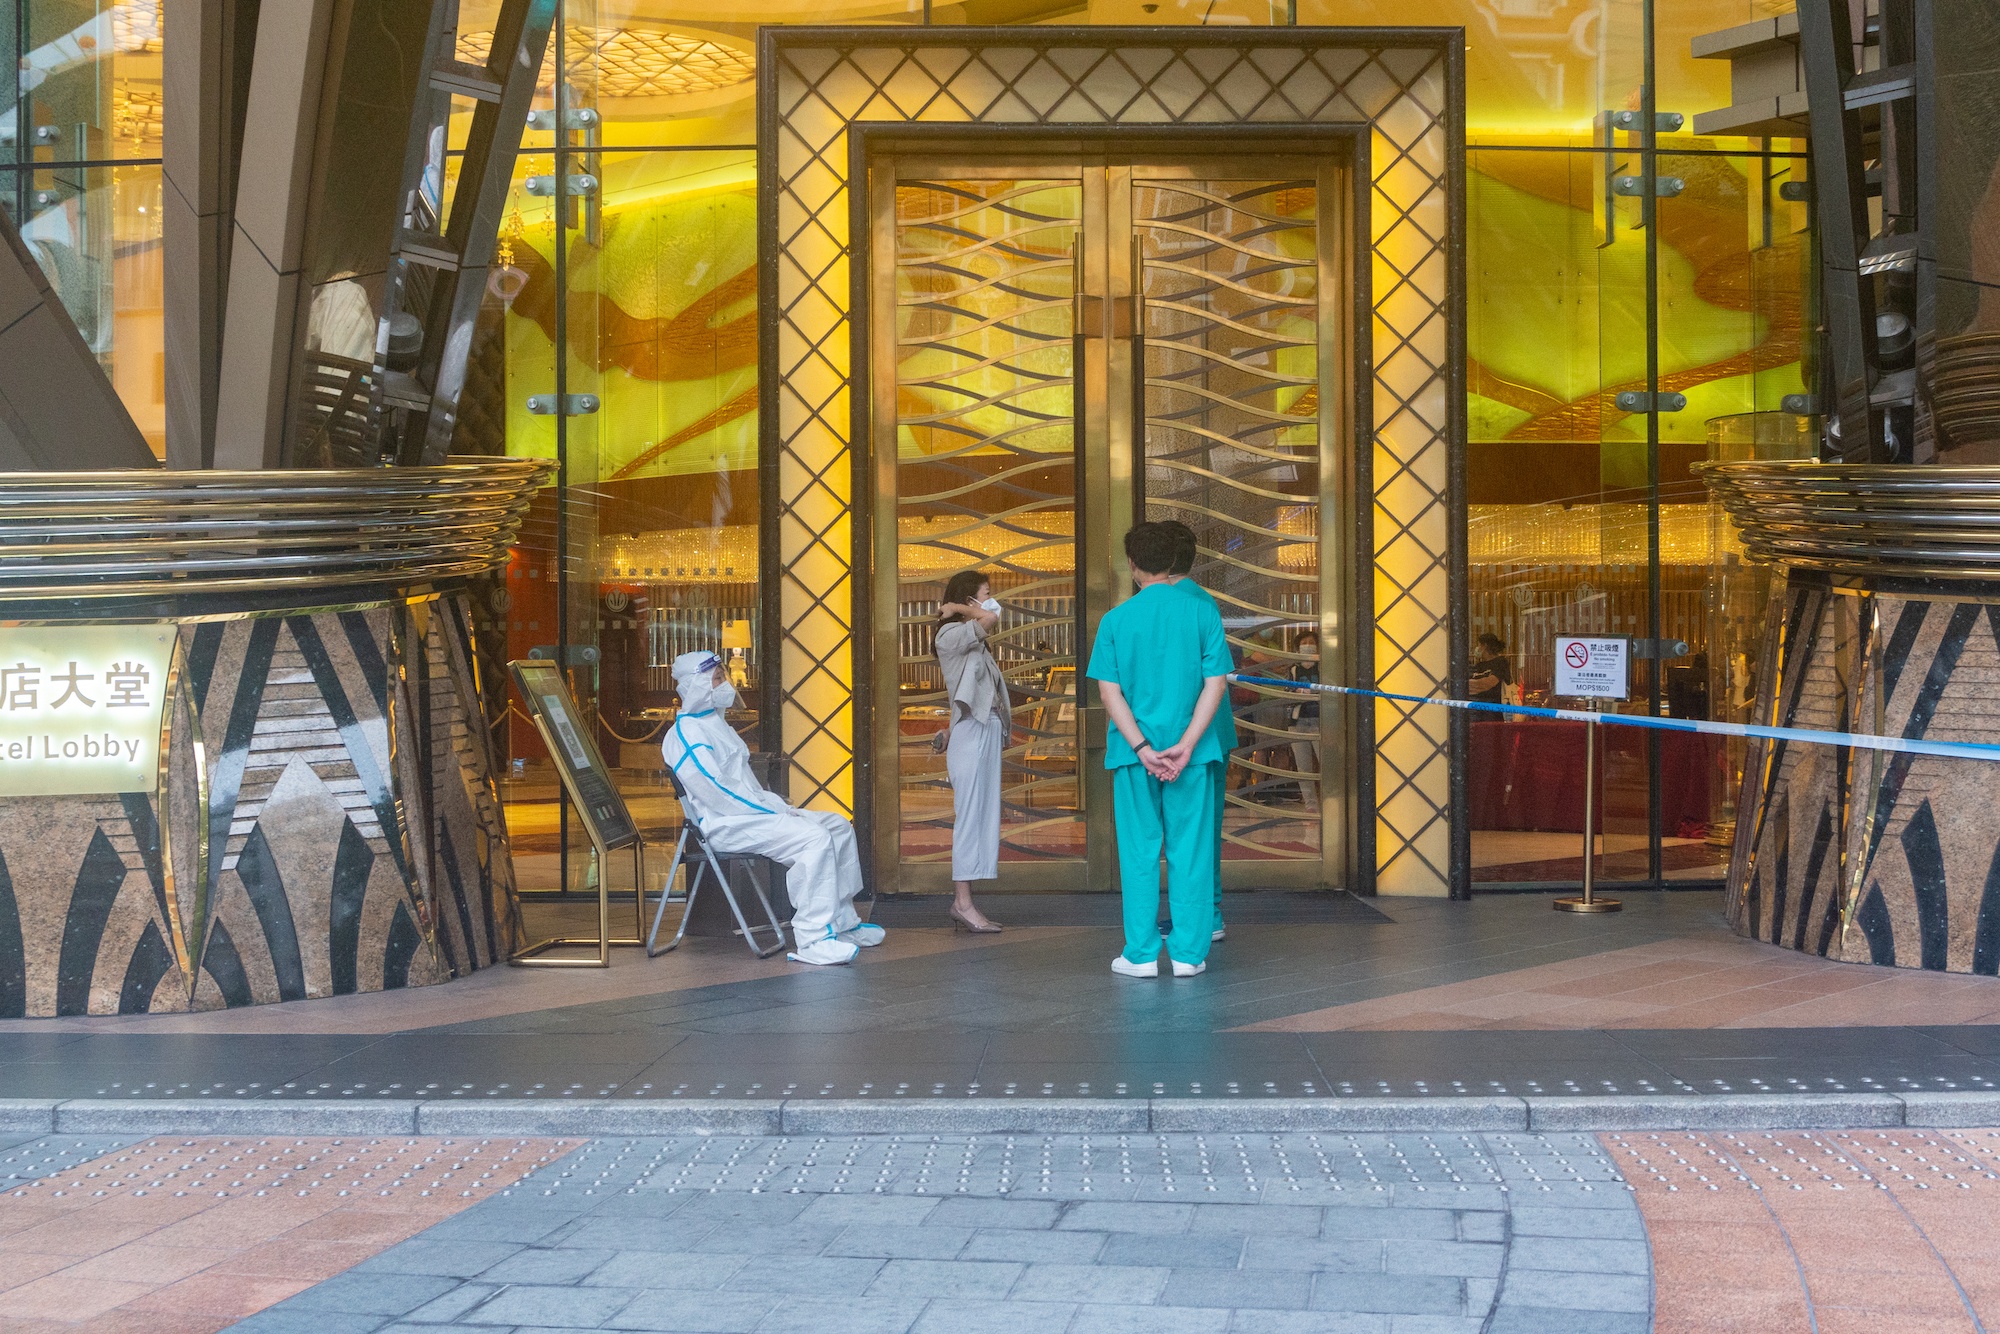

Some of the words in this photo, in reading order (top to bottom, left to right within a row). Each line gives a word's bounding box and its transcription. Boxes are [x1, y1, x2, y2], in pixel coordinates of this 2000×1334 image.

[1590, 644, 1619, 652] 禁止吸煙
[0, 662, 150, 710] 店大堂
[44, 734, 140, 762] Lobby
